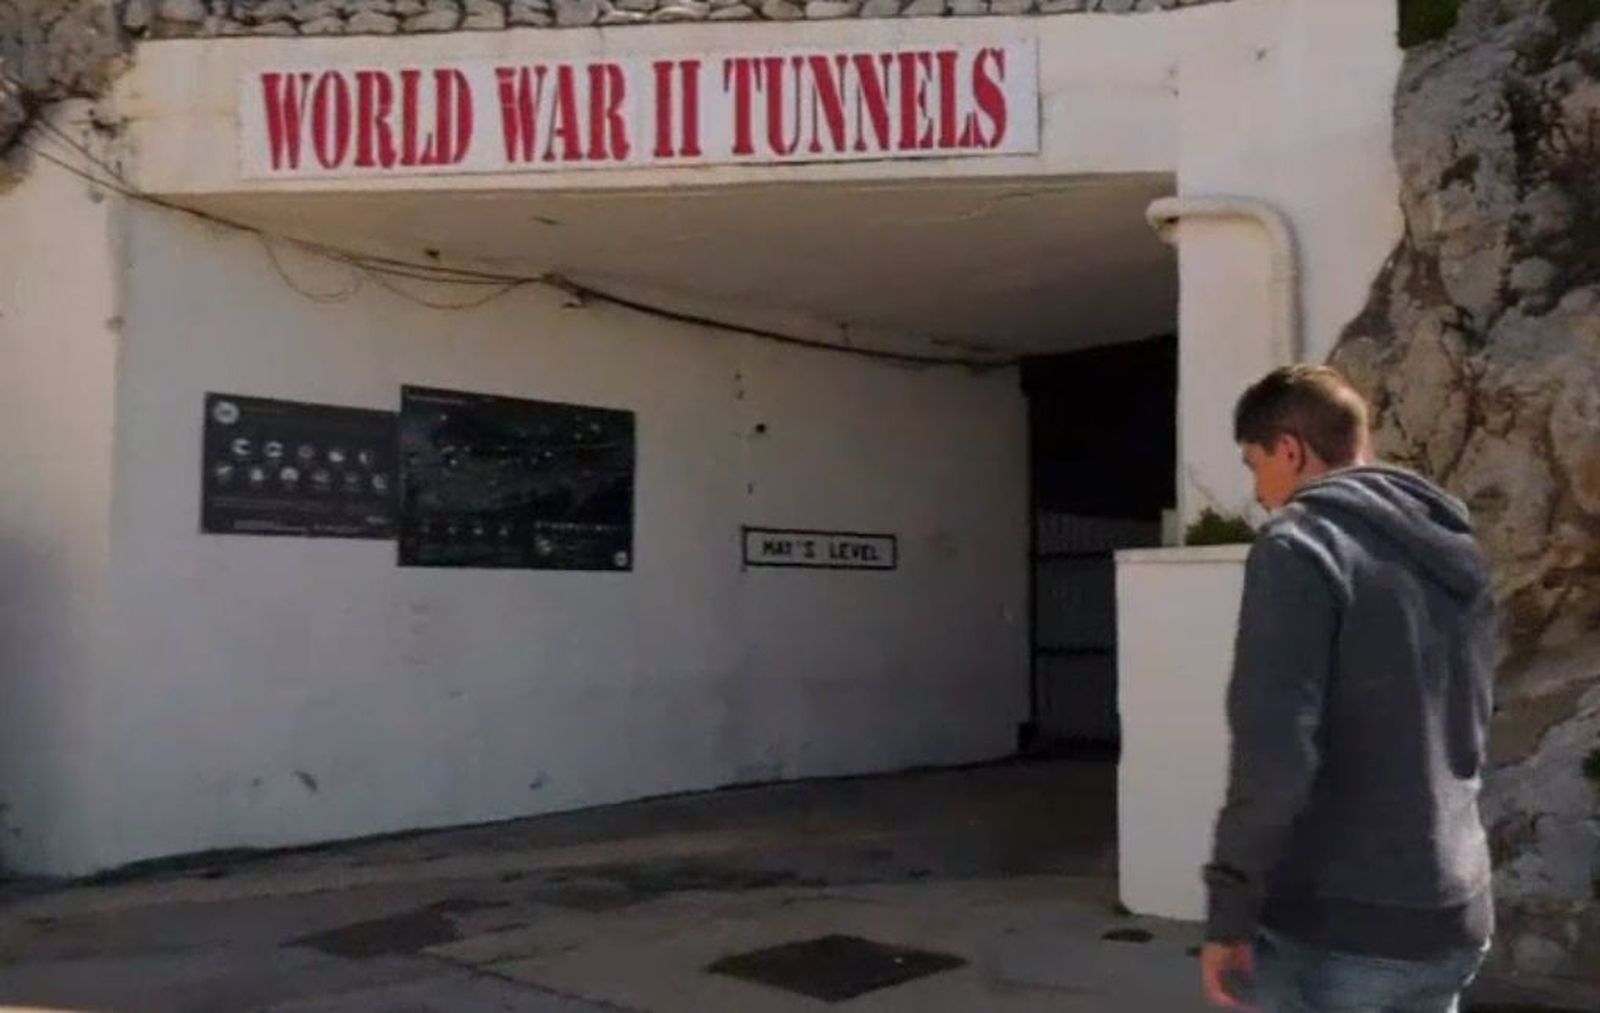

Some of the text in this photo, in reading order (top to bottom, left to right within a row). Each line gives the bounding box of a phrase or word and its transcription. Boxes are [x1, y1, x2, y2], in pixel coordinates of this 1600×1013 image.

[261, 47, 1008, 170] WORLD WAR II TUNNELS
[829, 541, 880, 561] LEVEL
